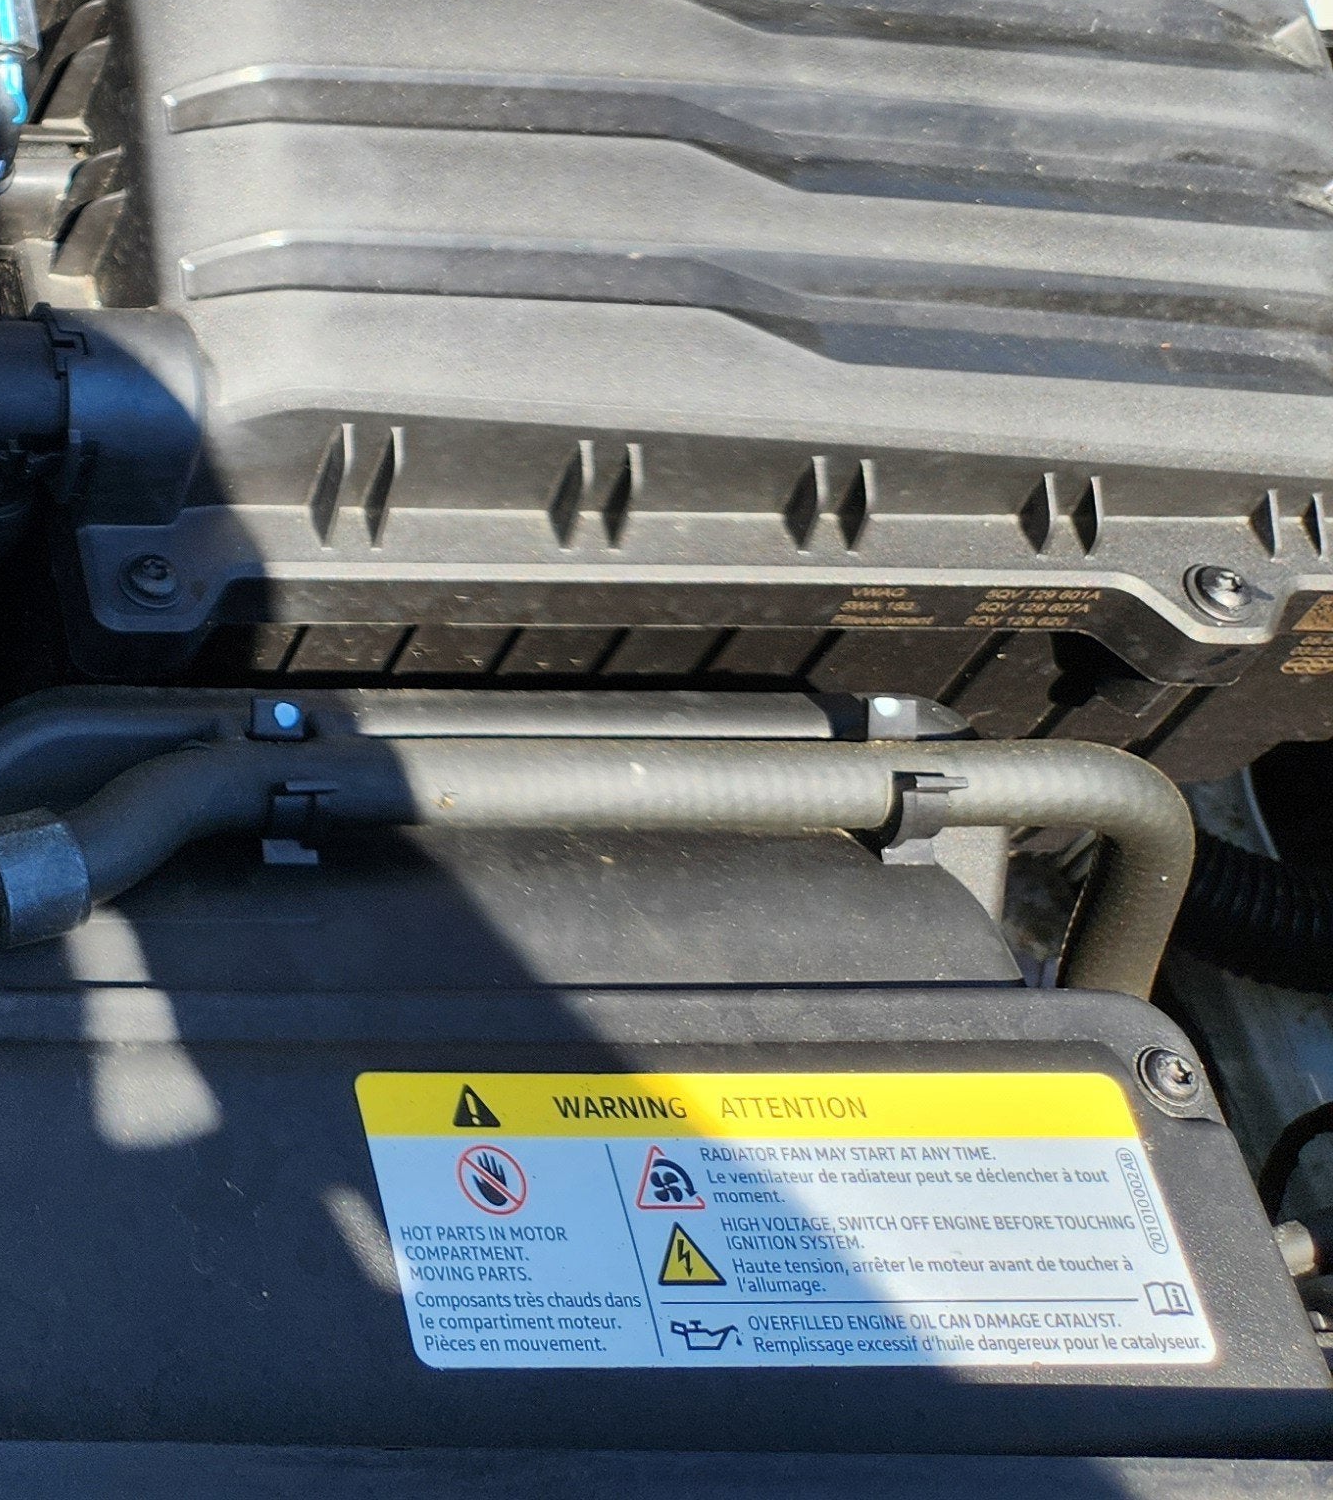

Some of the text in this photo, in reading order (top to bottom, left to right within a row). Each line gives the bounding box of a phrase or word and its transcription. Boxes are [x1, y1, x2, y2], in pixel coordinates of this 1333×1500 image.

[553, 1096, 869, 1119] WARNING ATTENTION
[700, 1146, 997, 1162] RADIATOR FAN MAY START AT ANY TIME.
[707, 1167, 1110, 1187] Le ventilateur de radiateur peut se déclencher à tout
[713, 1189, 786, 1203] moment.
[400, 1225, 568, 1241] HOT PARTS IN MOTOR
[721, 1215, 1136, 1234] HIGH VOLTAGE, SWITCH OFF ENGINE BEFORE TOUCHING
[726, 1235, 865, 1250] IGNITION SYSTEM.
[405, 1245, 530, 1261] COMPARTMENT.
[410, 1266, 532, 1281] MOVING PARTS.
[732, 1255, 1133, 1276] Haute tension, arrêter le moteur avant de toucher à
[737, 1278, 826, 1296] l'allumage.
[415, 1291, 642, 1312] Composants très chauds dans
[419, 1313, 622, 1333] le compartiment moteur.
[748, 1313, 1122, 1331] OVERFILLED ENGINE OIL CAN DAMAGE CATALYST.
[424, 1334, 607, 1352] Pièces en mouvement.
[753, 1334, 1206, 1356] Remplissage excessif d'huile dangereux pour le catalyseur.
